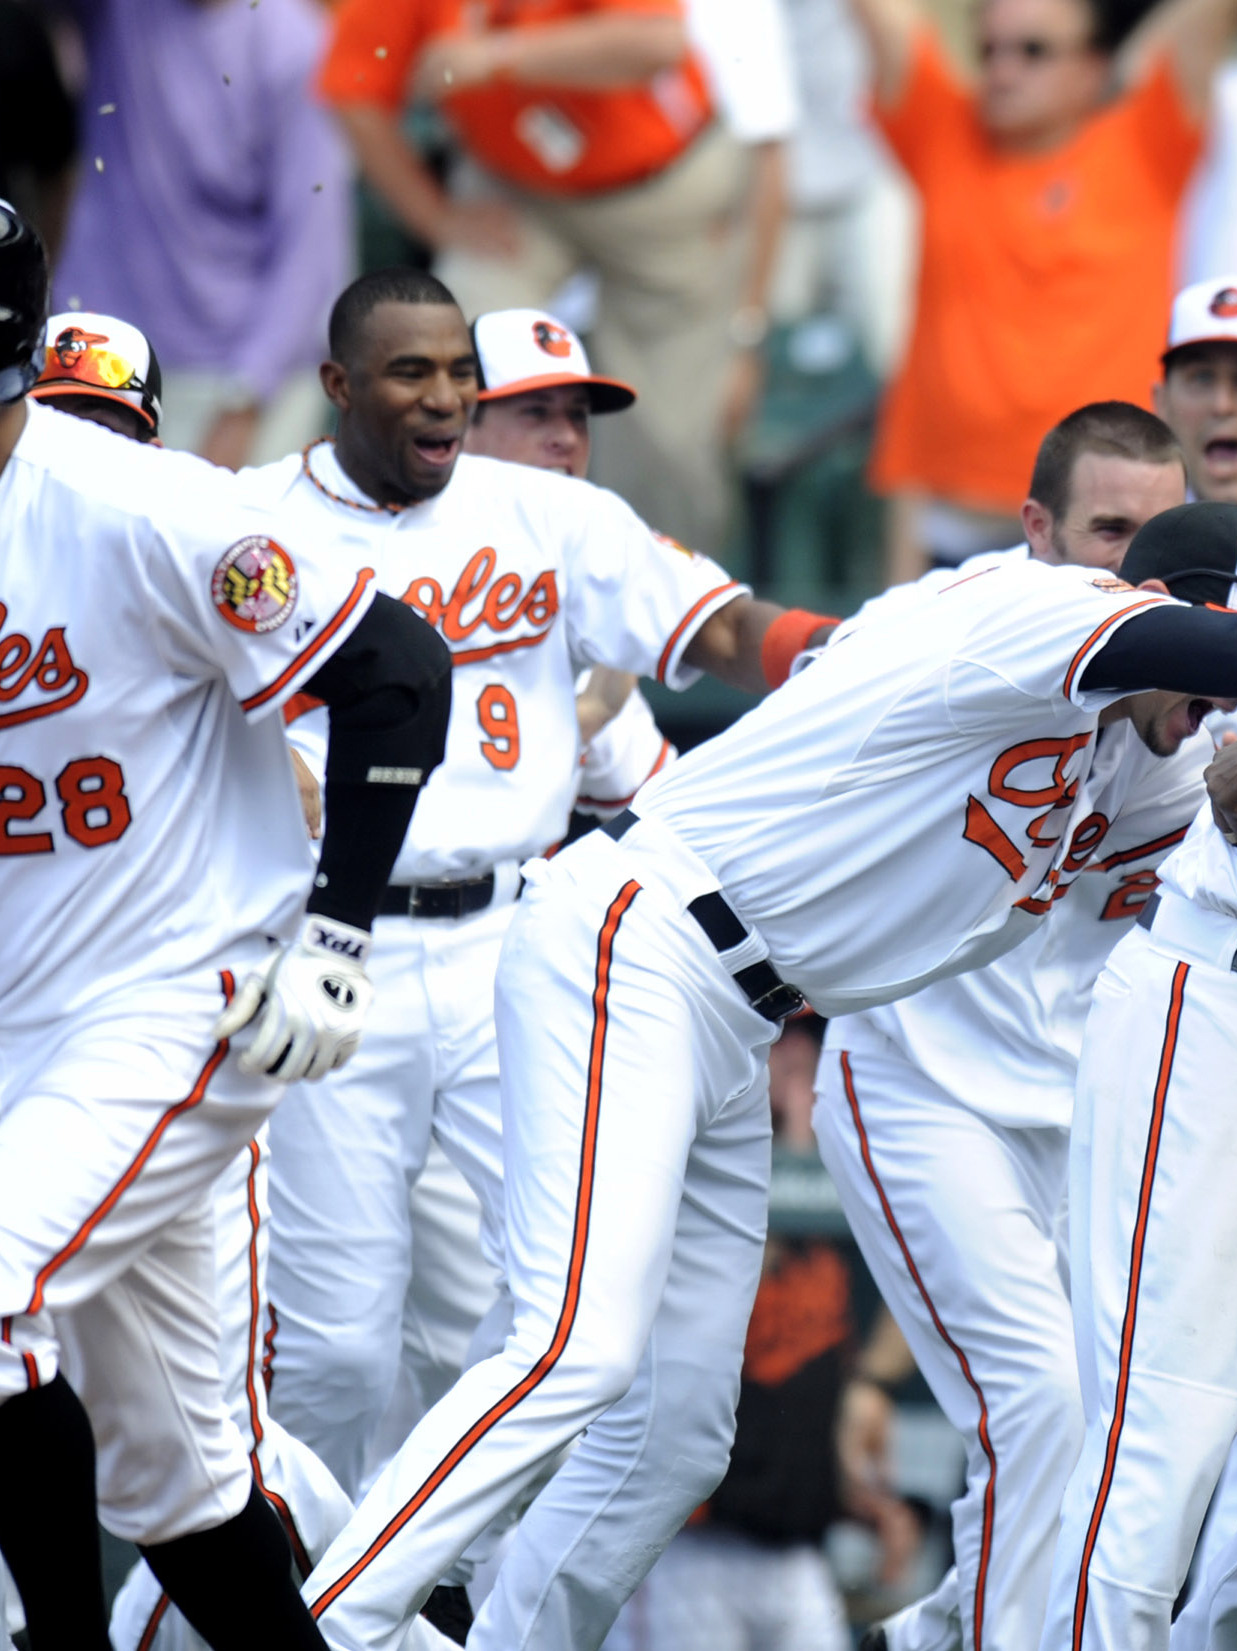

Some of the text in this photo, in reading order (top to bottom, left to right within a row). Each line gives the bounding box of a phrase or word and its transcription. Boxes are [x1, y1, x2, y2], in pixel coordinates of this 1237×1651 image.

[402, 546, 559, 655] oles
[476, 685, 521, 772] 9
[0, 756, 132, 855] 28
[316, 927, 364, 961] TPX
